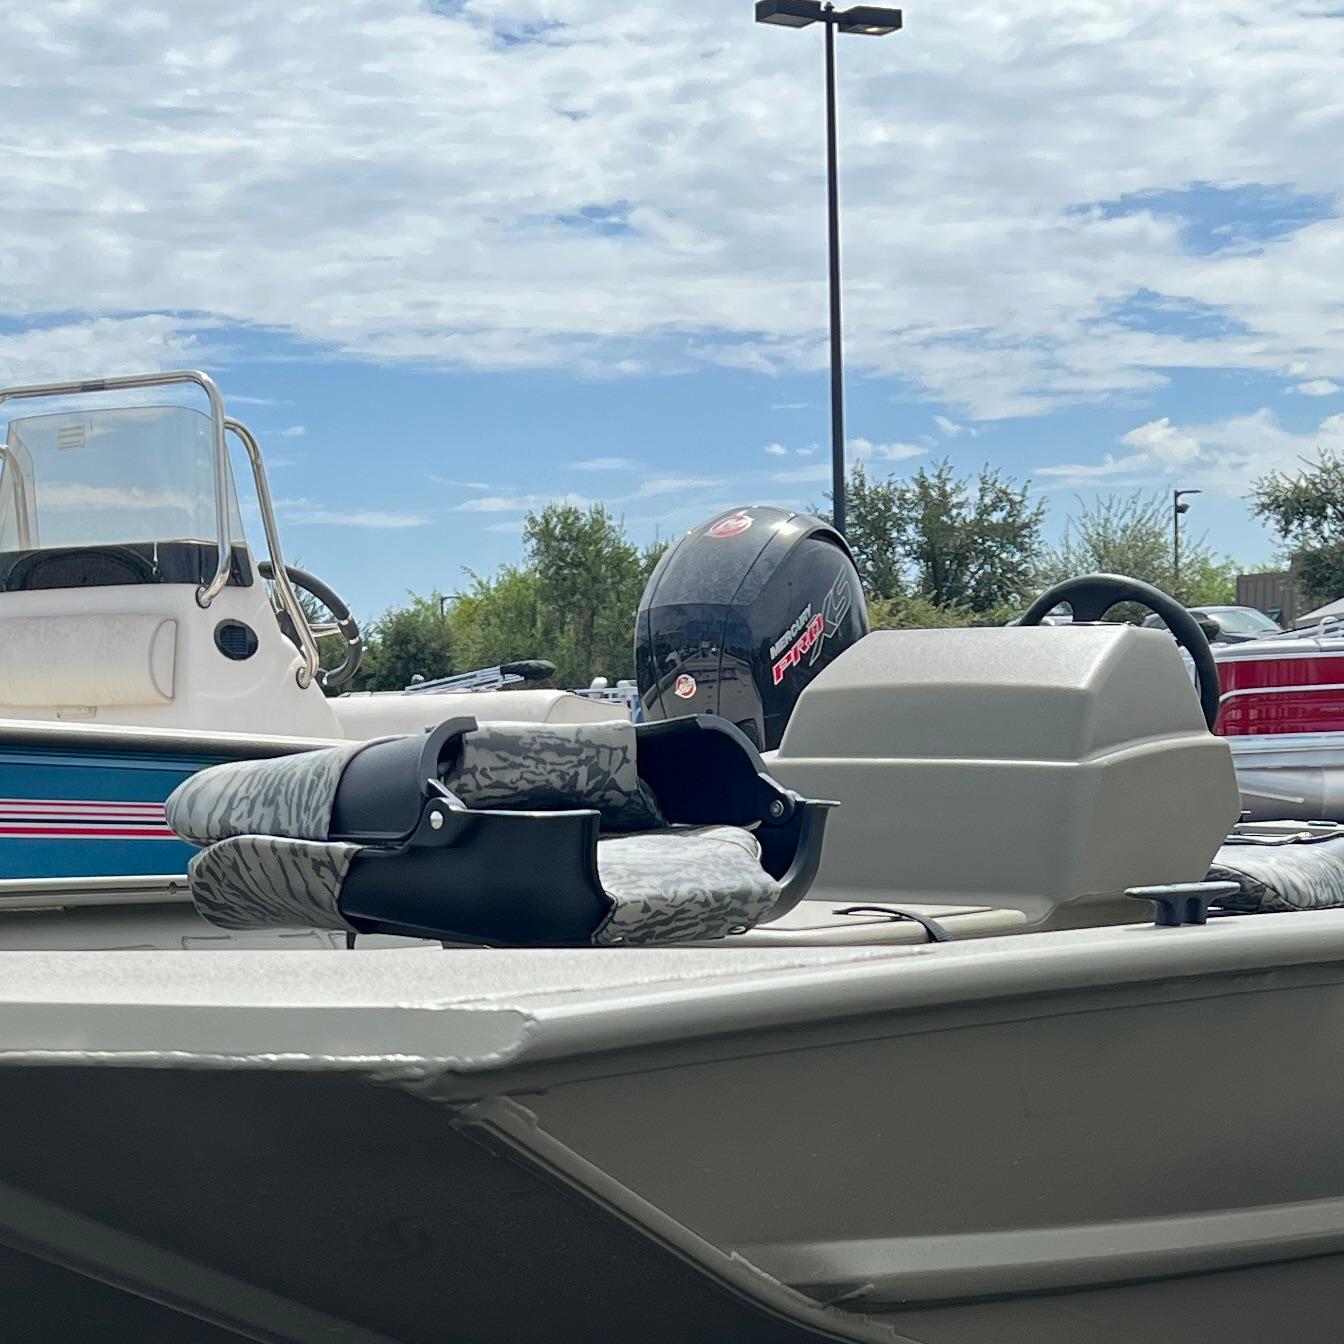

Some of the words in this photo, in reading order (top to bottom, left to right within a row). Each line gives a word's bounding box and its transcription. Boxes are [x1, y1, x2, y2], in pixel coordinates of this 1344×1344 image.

[769, 602, 811, 660] MERCURY
[772, 612, 824, 686] PRO
[808, 563, 852, 667] XS
